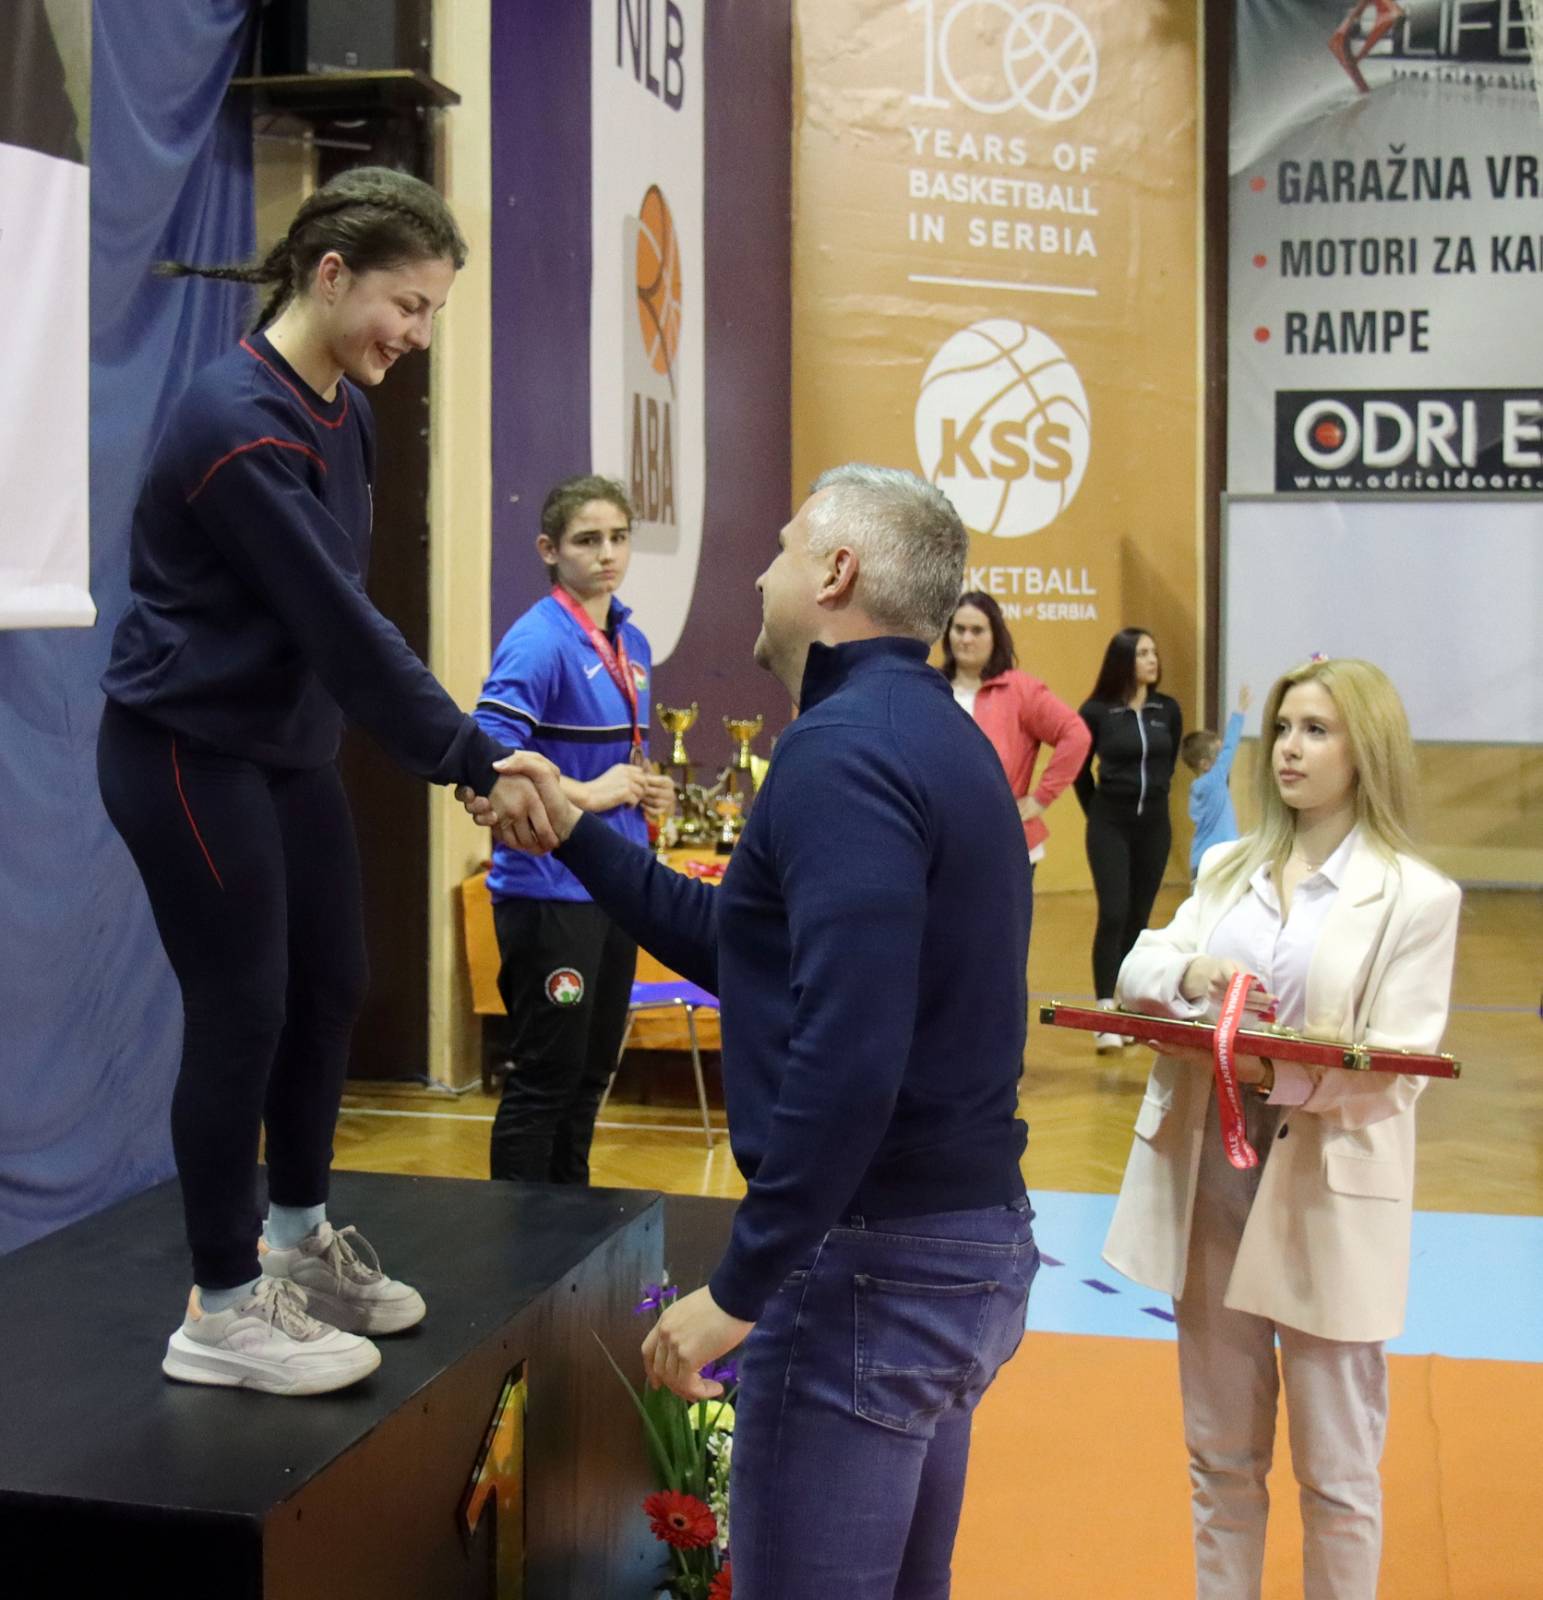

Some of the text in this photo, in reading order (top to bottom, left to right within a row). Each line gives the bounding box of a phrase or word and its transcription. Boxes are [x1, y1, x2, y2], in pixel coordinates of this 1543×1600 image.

[616, 0, 684, 113] NLB
[908, 127, 1099, 174] YEARS OF
[1276, 143, 1543, 205] GARAŽNA VR
[908, 169, 1099, 217] BASKETBALL
[908, 212, 1098, 258] IN SERBIA
[1280, 235, 1543, 278] MOTORI ZA KA
[1284, 309, 1430, 355] RAMPE
[631, 392, 676, 527] ABA
[941, 417, 1073, 482] KSS
[1036, 602, 1097, 622] SERBIA
[1217, 1016, 1233, 1087] TOURNAMENT
